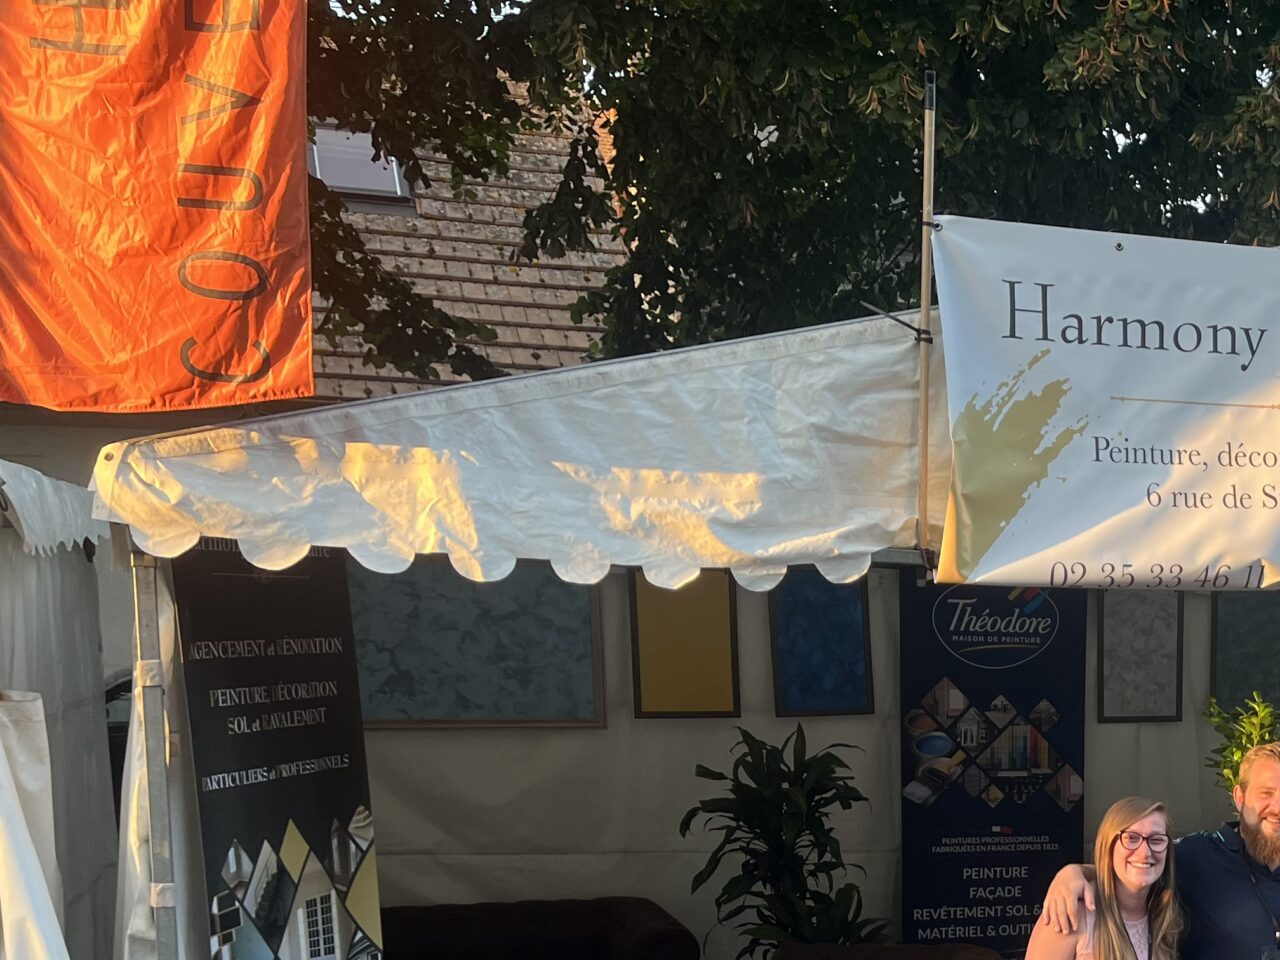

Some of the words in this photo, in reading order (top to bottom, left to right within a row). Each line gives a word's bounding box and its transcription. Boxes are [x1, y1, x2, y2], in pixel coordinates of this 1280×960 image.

[1001, 279, 1268, 371] Harmony
[1092, 436, 1208, 471] Peinture,
[1146, 482, 1162, 508] 6
[1172, 491, 1213, 509] rue
[1222, 485, 1252, 510] de
[1050, 561, 1087, 588] 02
[1098, 563, 1135, 588] 35
[1146, 563, 1183, 588] 33
[1194, 564, 1231, 589] 46
[947, 598, 1052, 634] Théodore
[188, 639, 266, 660] AGENCEMENT
[952, 634, 985, 642] MAISON
[987, 635, 998, 643] DE
[1001, 636, 1041, 644] PEINTURE
[227, 715, 251, 735] SOL
[202, 766, 268, 792] PARTICULIERS
[963, 866, 1029, 880] PEINTURE
[969, 885, 1022, 901] FAÇADE
[913, 905, 1003, 921] REVÊTEMENT
[1005, 905, 1030, 917] SOL
[1032, 905, 1042, 916] &
[918, 925, 985, 941] MATÉRIEL
[986, 925, 996, 937] &
